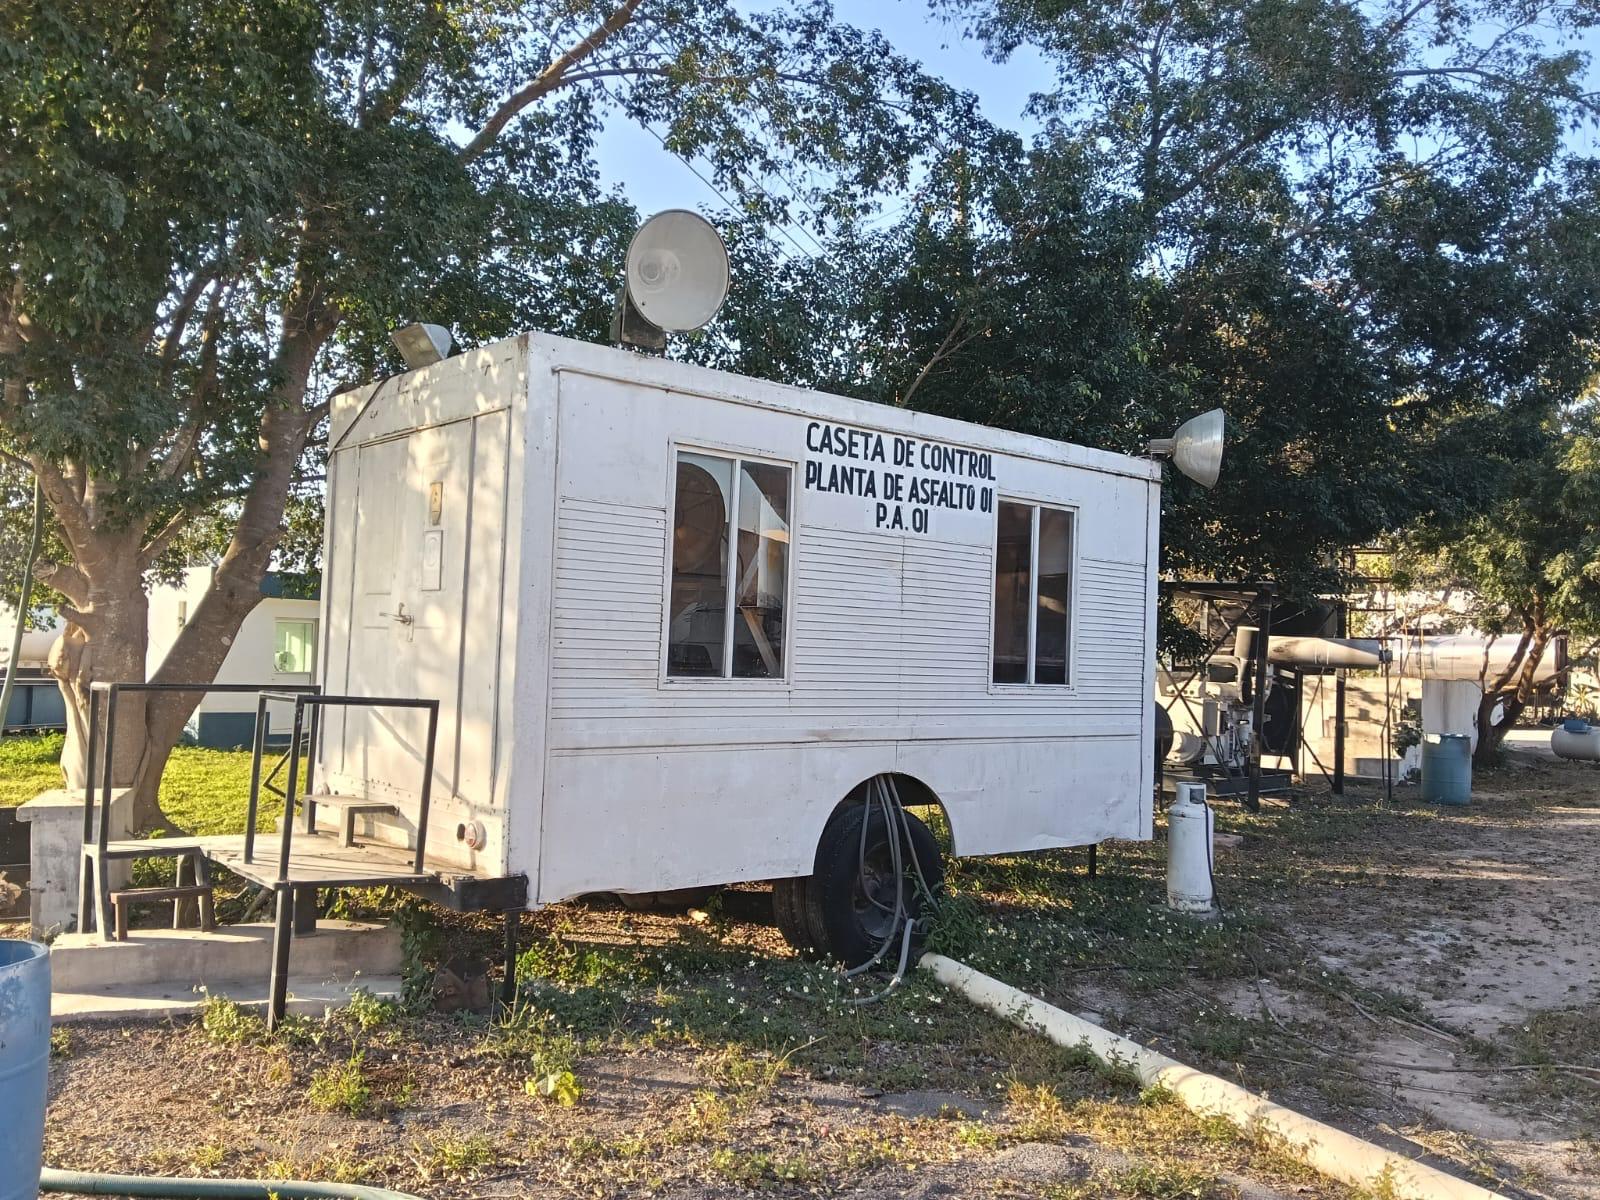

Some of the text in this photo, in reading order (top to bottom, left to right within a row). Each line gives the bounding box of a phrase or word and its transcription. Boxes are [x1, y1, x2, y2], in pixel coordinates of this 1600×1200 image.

[807, 422, 996, 481] CASETA DE CONTROL
[805, 460, 876, 498] PLANTA
[884, 472, 904, 502] DE
[908, 477, 975, 511] ASFALTO
